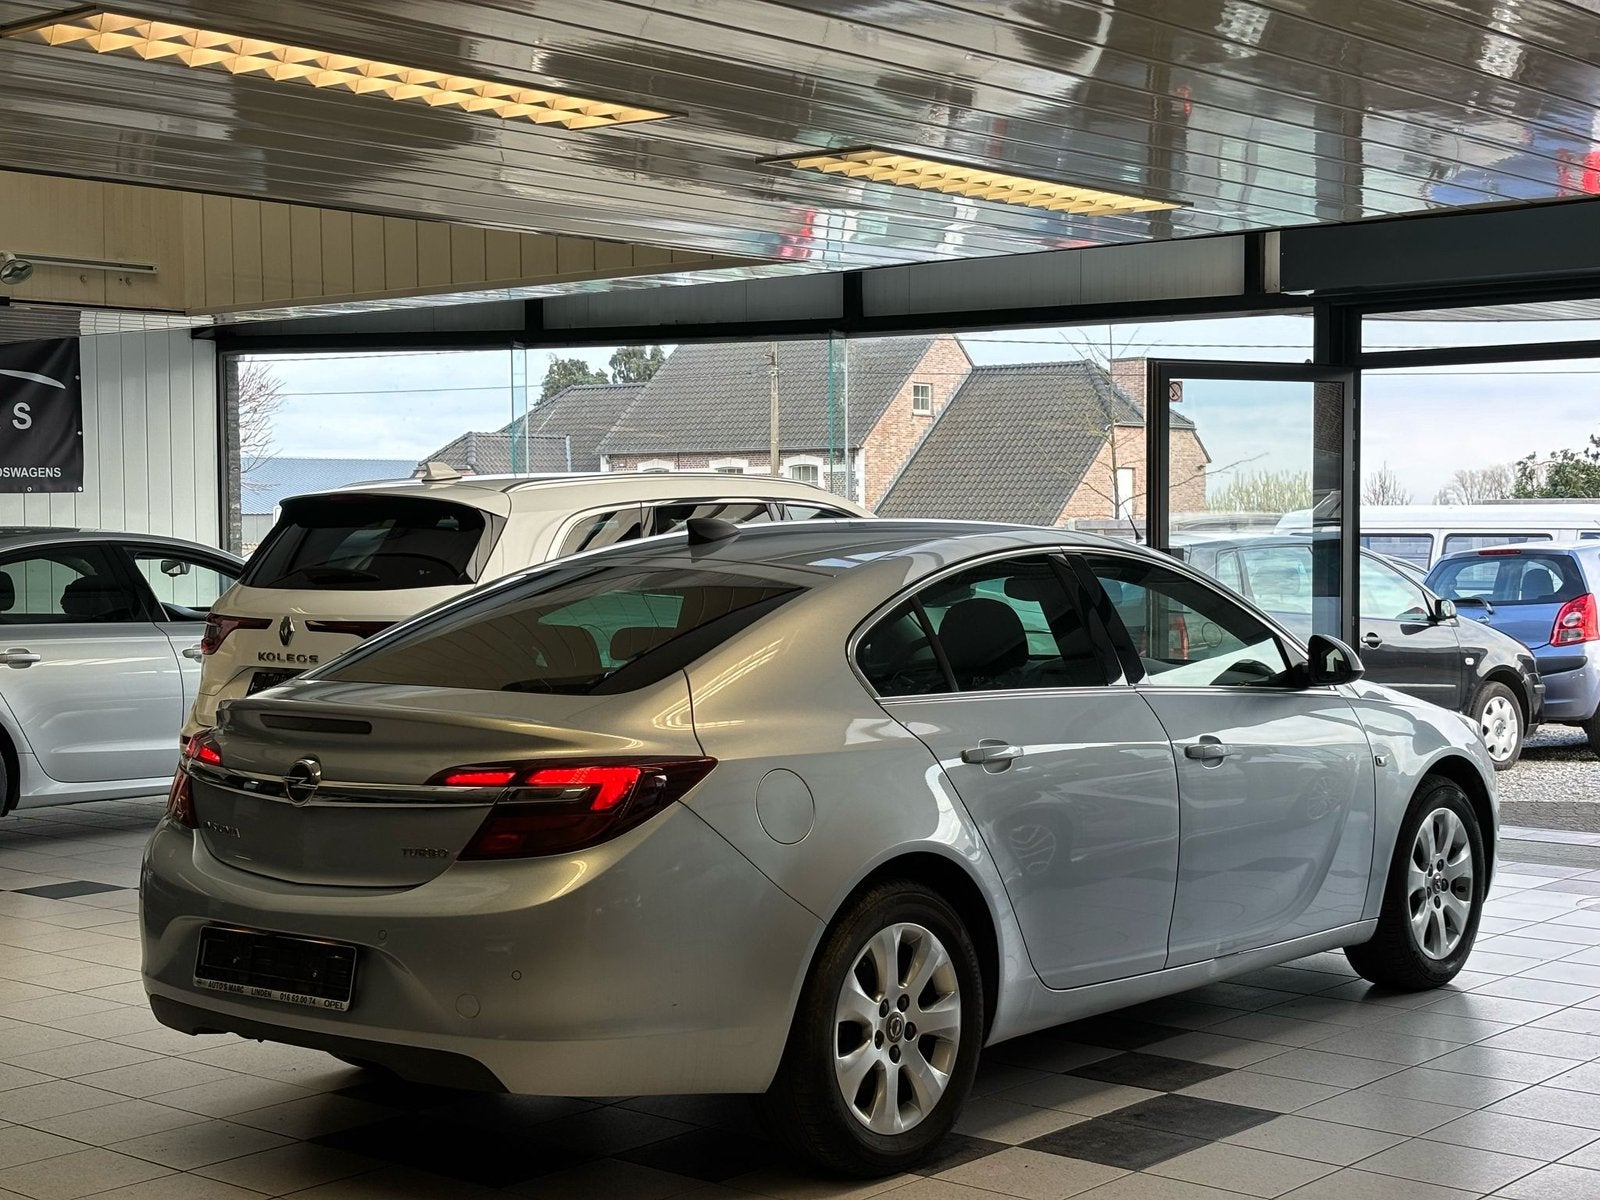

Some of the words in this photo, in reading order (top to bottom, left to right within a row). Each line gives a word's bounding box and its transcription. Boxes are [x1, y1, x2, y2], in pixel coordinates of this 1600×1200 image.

[12, 402, 32, 430] S
[0, 467, 62, 478] SWAGENS
[257, 651, 319, 664] KOLEOS
[401, 847, 449, 858] TURBO
[251, 987, 272, 998] LINDEN
[324, 1000, 344, 1010] OPEL
